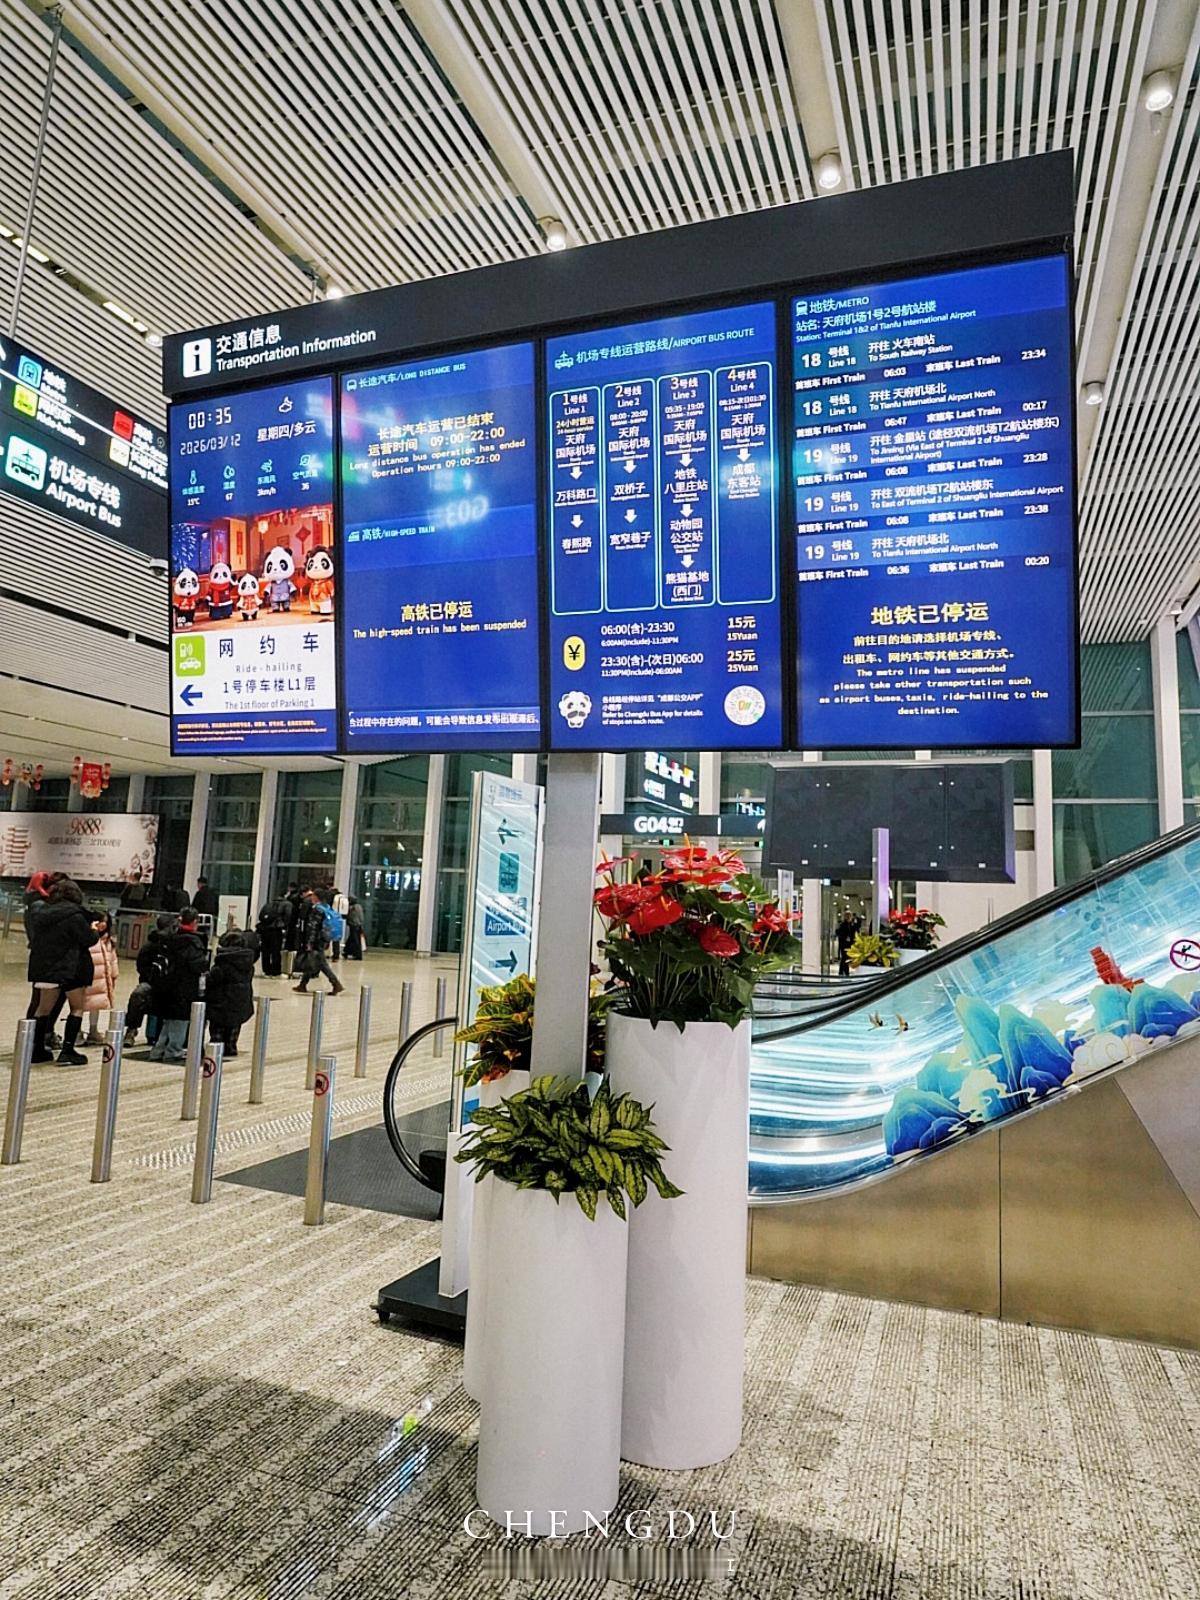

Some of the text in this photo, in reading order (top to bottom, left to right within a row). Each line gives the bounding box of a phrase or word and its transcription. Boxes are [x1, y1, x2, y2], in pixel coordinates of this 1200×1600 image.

[809, 297, 869, 314] 地铁/METRO
[823, 300, 937, 328] 天府机场1号2号航站楼
[796, 334, 821, 343] Station:
[823, 329, 852, 339] Terminal
[880, 321, 901, 331] Tianfu
[903, 313, 948, 328] International
[950, 310, 976, 320] Airport
[216, 325, 281, 355] 交通信息
[709, 332, 725, 343] BUS
[727, 328, 755, 341] ROUTE
[217, 329, 376, 372] Transportation Information
[828, 345, 849, 358] 号线
[453, 363, 466, 372] BUS
[802, 353, 821, 368] 18
[829, 358, 845, 367] Line
[955, 355, 1000, 368] Last Train
[822, 376, 841, 385] First
[843, 373, 865, 382] Train
[730, 382, 755, 392] Line 4
[974, 389, 996, 397] North
[673, 390, 696, 400] Line 3
[829, 394, 850, 406] 号线
[617, 398, 640, 408] Line 2
[803, 401, 822, 415] 18
[956, 401, 1047, 419] Last Train 00:17
[564, 406, 580, 415] Line
[829, 408, 845, 416] Line
[188, 407, 232, 430] 00:35
[674, 419, 696, 432] 天府
[731, 413, 754, 426] 天府
[257, 420, 316, 443] 星期四/多云
[377, 412, 495, 440] 长途汽车运营已结束
[619, 426, 639, 439] 天府
[720, 424, 766, 441] 国际机场
[823, 422, 866, 433] First Train
[179, 433, 241, 456] 2026/03/12
[368, 427, 505, 457] 运营时间 09:00-22:00
[565, 433, 586, 446] 天府
[608, 437, 650, 453] 国际机场
[663, 430, 707, 446] 国际机场
[870, 435, 891, 446] 开往
[946, 438, 976, 447] Terminal
[372, 439, 526, 468] distance bus operation has ended
[556, 444, 596, 459] 国际机场
[830, 443, 851, 454] 号线
[804, 449, 822, 463] 19
[831, 456, 846, 464] Line
[871, 454, 913, 464] International
[957, 453, 1048, 469] Last Train 23:28
[372, 454, 500, 478] Operation hours 09:00-22:00
[49, 456, 120, 508] 机场专线
[824, 471, 867, 482] First Train
[664, 480, 708, 495] 八里庄站
[871, 488, 892, 500] 开往
[831, 491, 852, 503] 号线
[907, 486, 1063, 505] Terminal International Airport
[46, 482, 121, 527] Airport Bus
[805, 497, 824, 512] 19
[831, 504, 847, 513] Line
[958, 505, 1048, 520] Last Train 23:38
[825, 519, 868, 530] First Train
[832, 539, 852, 551] 号线
[872, 538, 893, 550] 开往
[883, 542, 998, 557] Tianfu International Airport North
[805, 545, 824, 560] 19
[832, 553, 848, 561] Line
[959, 556, 1049, 570] Last Train 00:20
[826, 568, 869, 579] First Train
[401, 601, 473, 622] 高铁已停运
[871, 602, 989, 625] 地铁已停运
[353, 619, 527, 639] The high-speed train has been suspended
[601, 622, 675, 635] 06:00(含)-23:30
[728, 616, 756, 629] 15元
[727, 632, 758, 641] 15Yuan
[853, 630, 1001, 647] 前往目的地请选择机场专线、
[601, 653, 704, 667] 23:30(含)-(次日)06:00
[727, 649, 755, 662] 25元
[727, 663, 759, 673] 25Yuan
[856, 664, 1006, 677] The metro line has suspended
[223, 676, 316, 695] 1号停车楼L1层
[833, 676, 1032, 691] please take other transportation such
[834, 690, 1049, 704] airport ride-hailing to the
[225, 701, 238, 710] The
[251, 700, 269, 709] floor
[280, 699, 309, 710] Parking
[634, 816, 668, 833] G04
[487, 920, 510, 935] Airport
